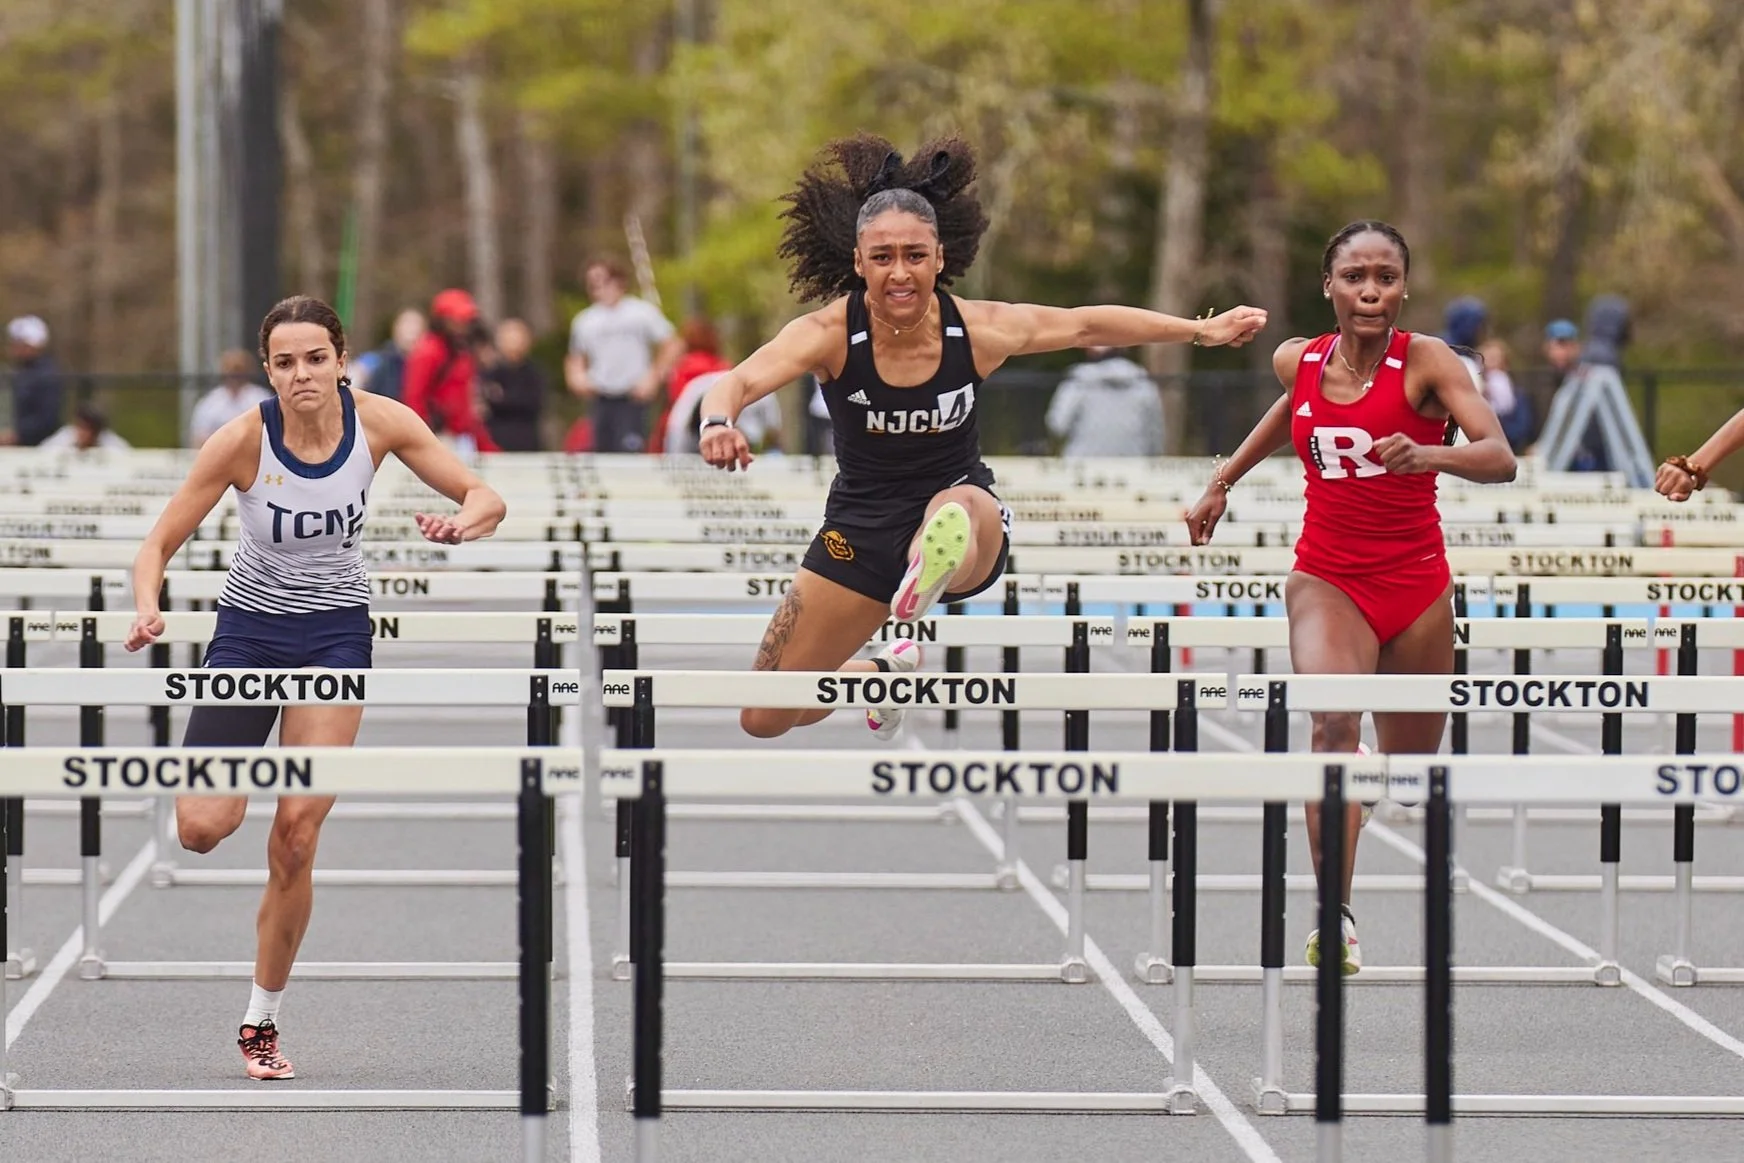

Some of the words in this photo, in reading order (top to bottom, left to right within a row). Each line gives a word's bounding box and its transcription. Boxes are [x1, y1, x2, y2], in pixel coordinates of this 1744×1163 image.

[1313, 426, 1387, 479] R
[1119, 554, 1241, 568] STOCKTON
[1511, 555, 1633, 569] STOCKTON
[1196, 581, 1281, 599] STOCK
[165, 673, 366, 700] STOCKTON
[816, 677, 1016, 704] STOCKTON
[1449, 680, 1649, 708] STOCKTON
[63, 757, 312, 789] STOCKTON
[871, 762, 1119, 794] STOCKTON
[1656, 765, 1740, 795] STO
